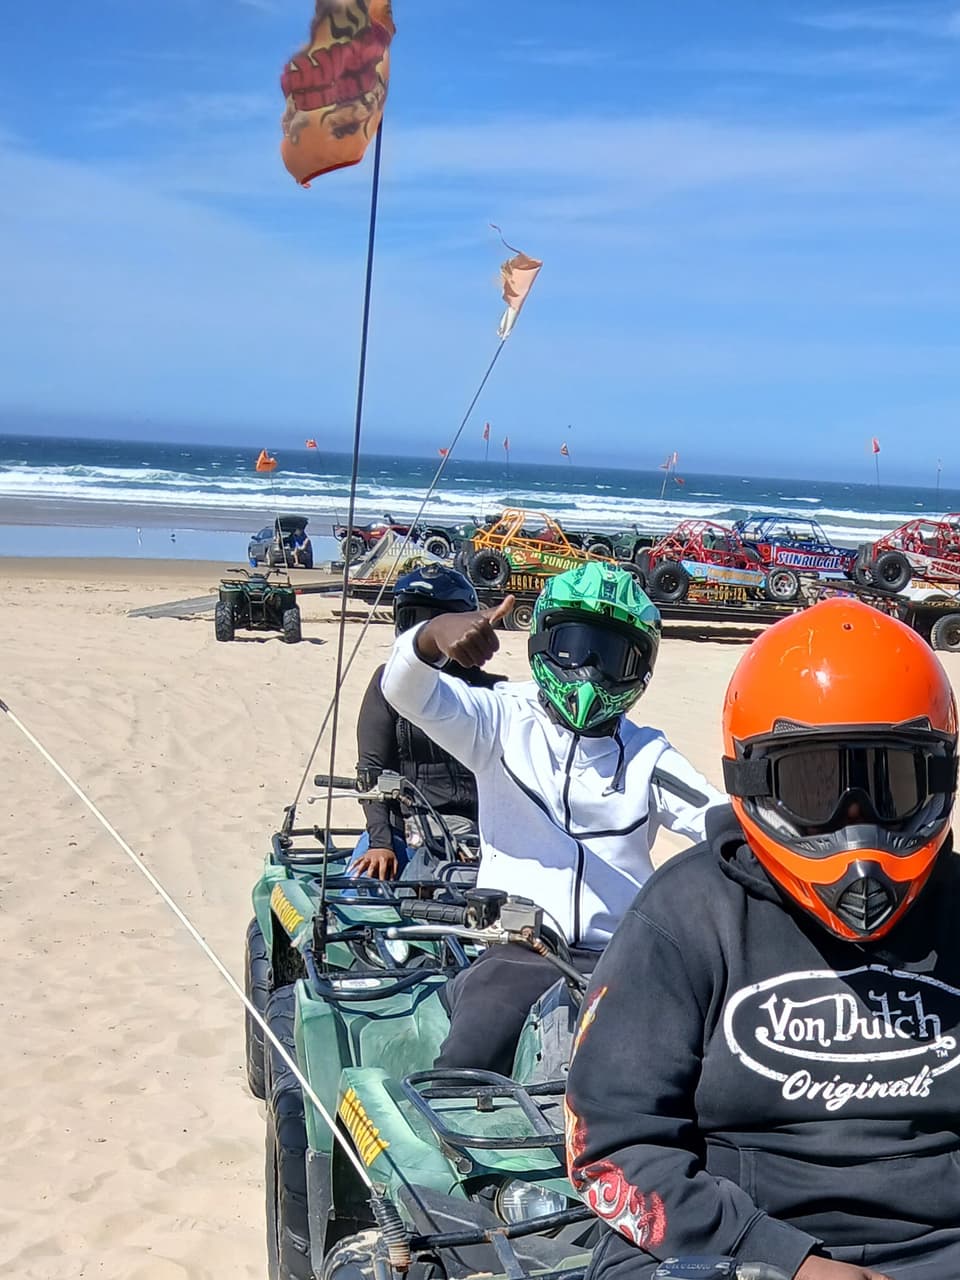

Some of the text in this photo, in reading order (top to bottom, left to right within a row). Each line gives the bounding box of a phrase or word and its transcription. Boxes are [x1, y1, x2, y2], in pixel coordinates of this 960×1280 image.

[759, 989, 942, 1047] Von Dutch
[781, 1065, 935, 1112] Originals
